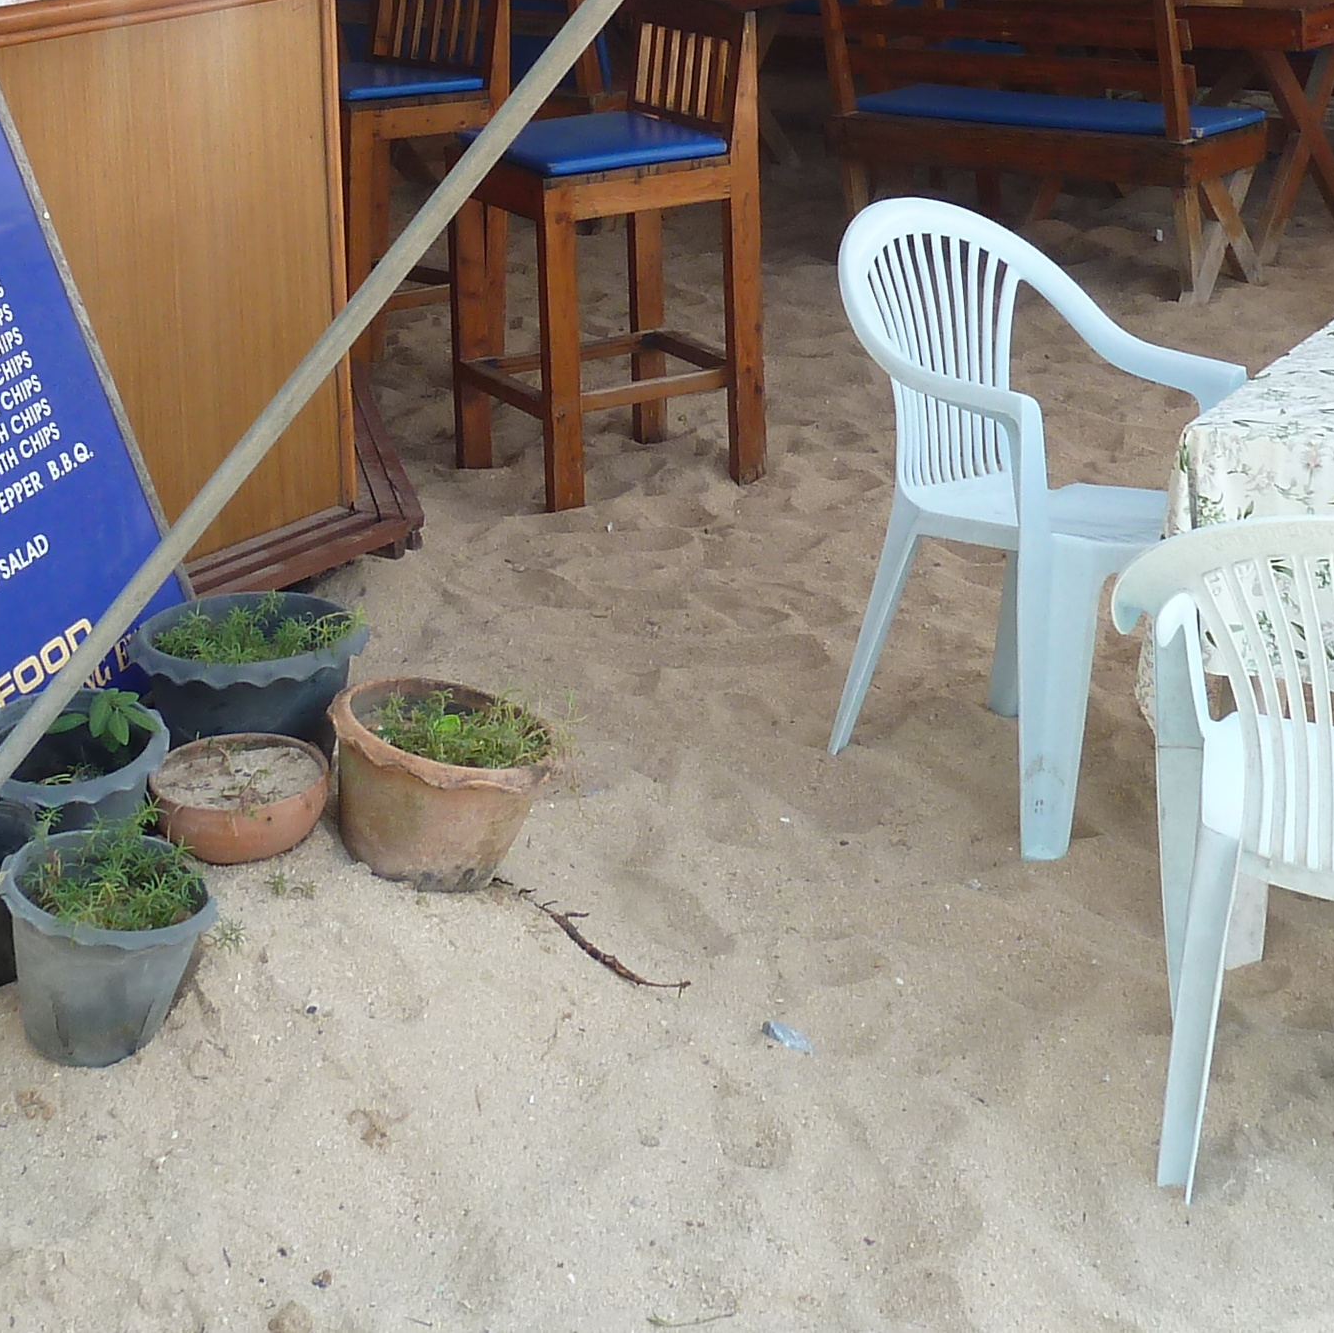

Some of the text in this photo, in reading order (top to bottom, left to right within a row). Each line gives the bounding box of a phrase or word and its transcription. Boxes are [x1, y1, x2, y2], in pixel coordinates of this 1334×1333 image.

[0, 375, 41, 410] CHIPS
[11, 398, 51, 434] CHIPS
[19, 422, 60, 458] CHIPS
[47, 443, 94, 481] B.B.Q.
